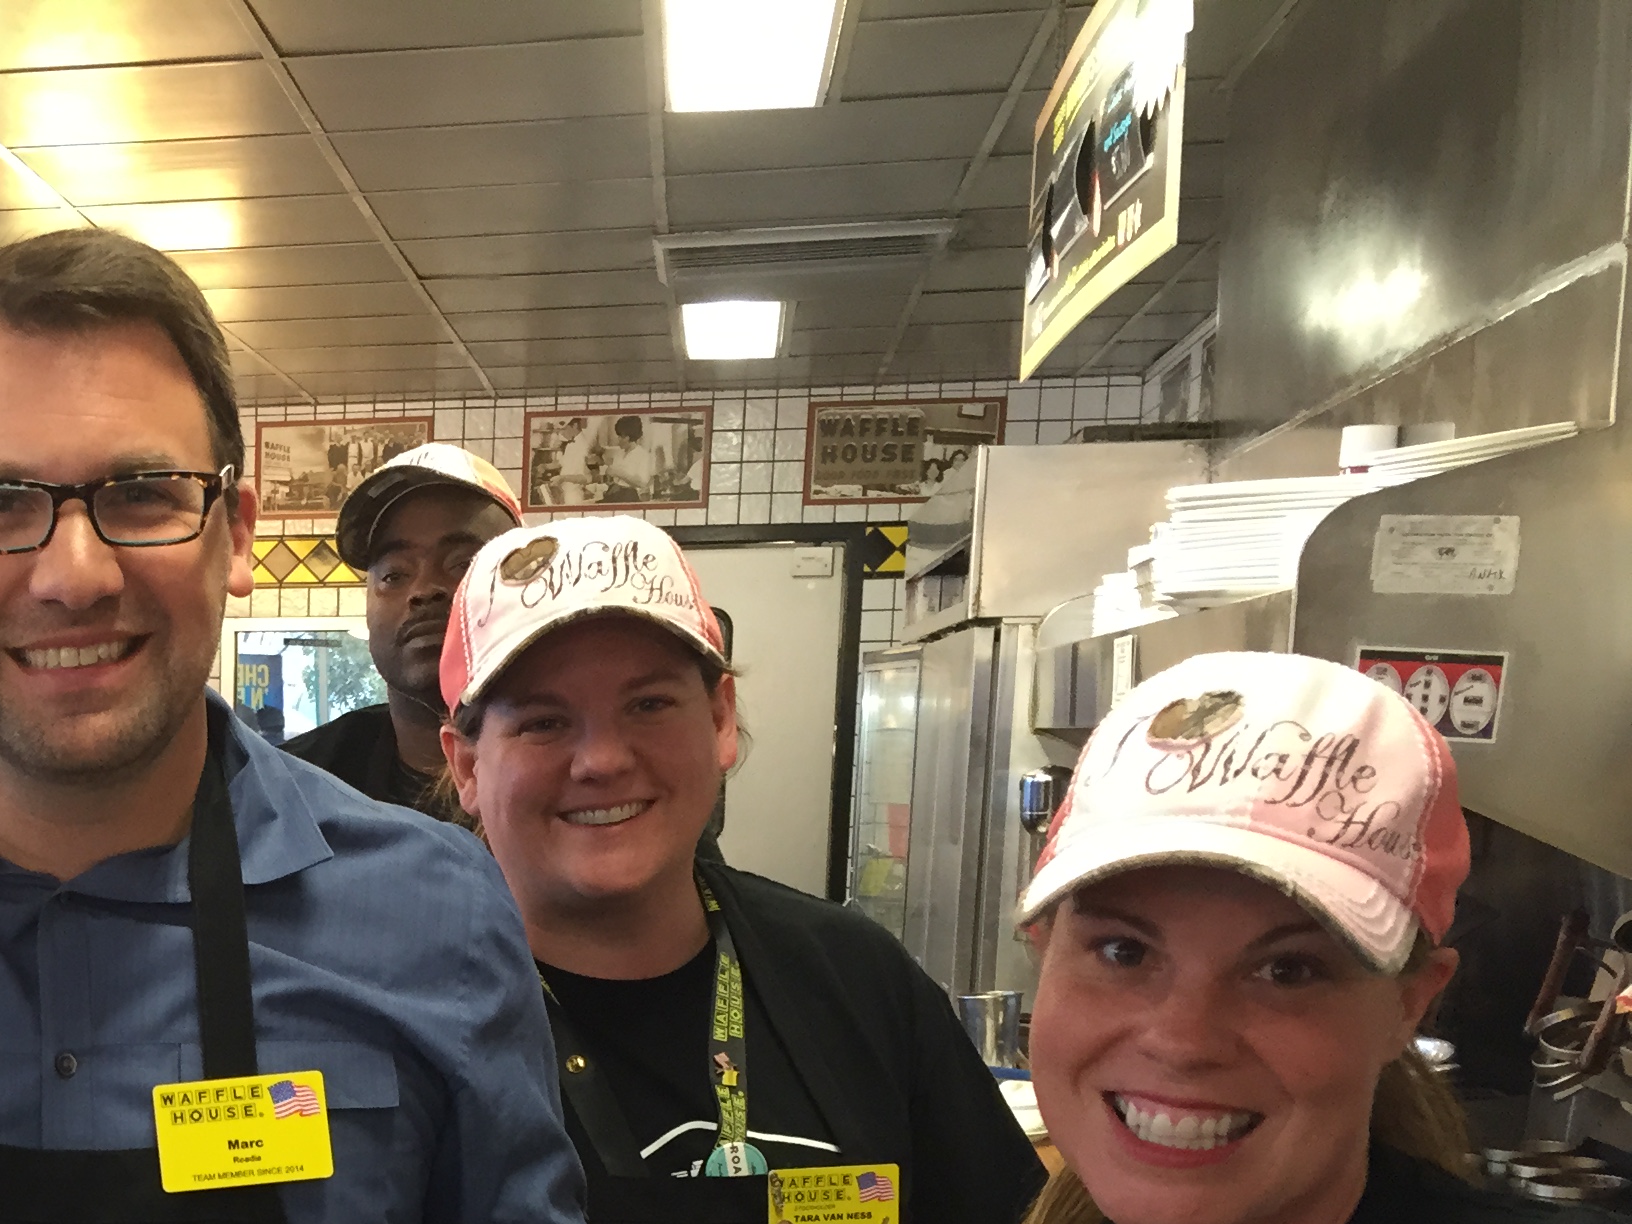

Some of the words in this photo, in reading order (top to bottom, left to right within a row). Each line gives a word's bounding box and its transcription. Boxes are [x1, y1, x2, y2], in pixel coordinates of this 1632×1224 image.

[820, 415, 920, 438] WAFFLE
[264, 441, 291, 451] WAFFLE
[821, 441, 917, 464] HOUSE
[264, 451, 291, 462] HOUSE
[521, 540, 659, 609] Waffle
[1146, 720, 1378, 808] Waffle
[713, 951, 730, 1042] WAFFLE
[161, 1084, 262, 1107] WAFFLE
[227, 1138, 264, 1150] Marc
[233, 1155, 262, 1164] Roadie
[192, 1173, 216, 1182] TEAM
[217, 1169, 255, 1180] MEMBER
[256, 1166, 284, 1176] SINCE
[285, 1164, 304, 1174] 2014
[794, 1214, 820, 1222] TARA
[822, 1213, 844, 1221] VAN
[846, 1211, 872, 1220] NESS
